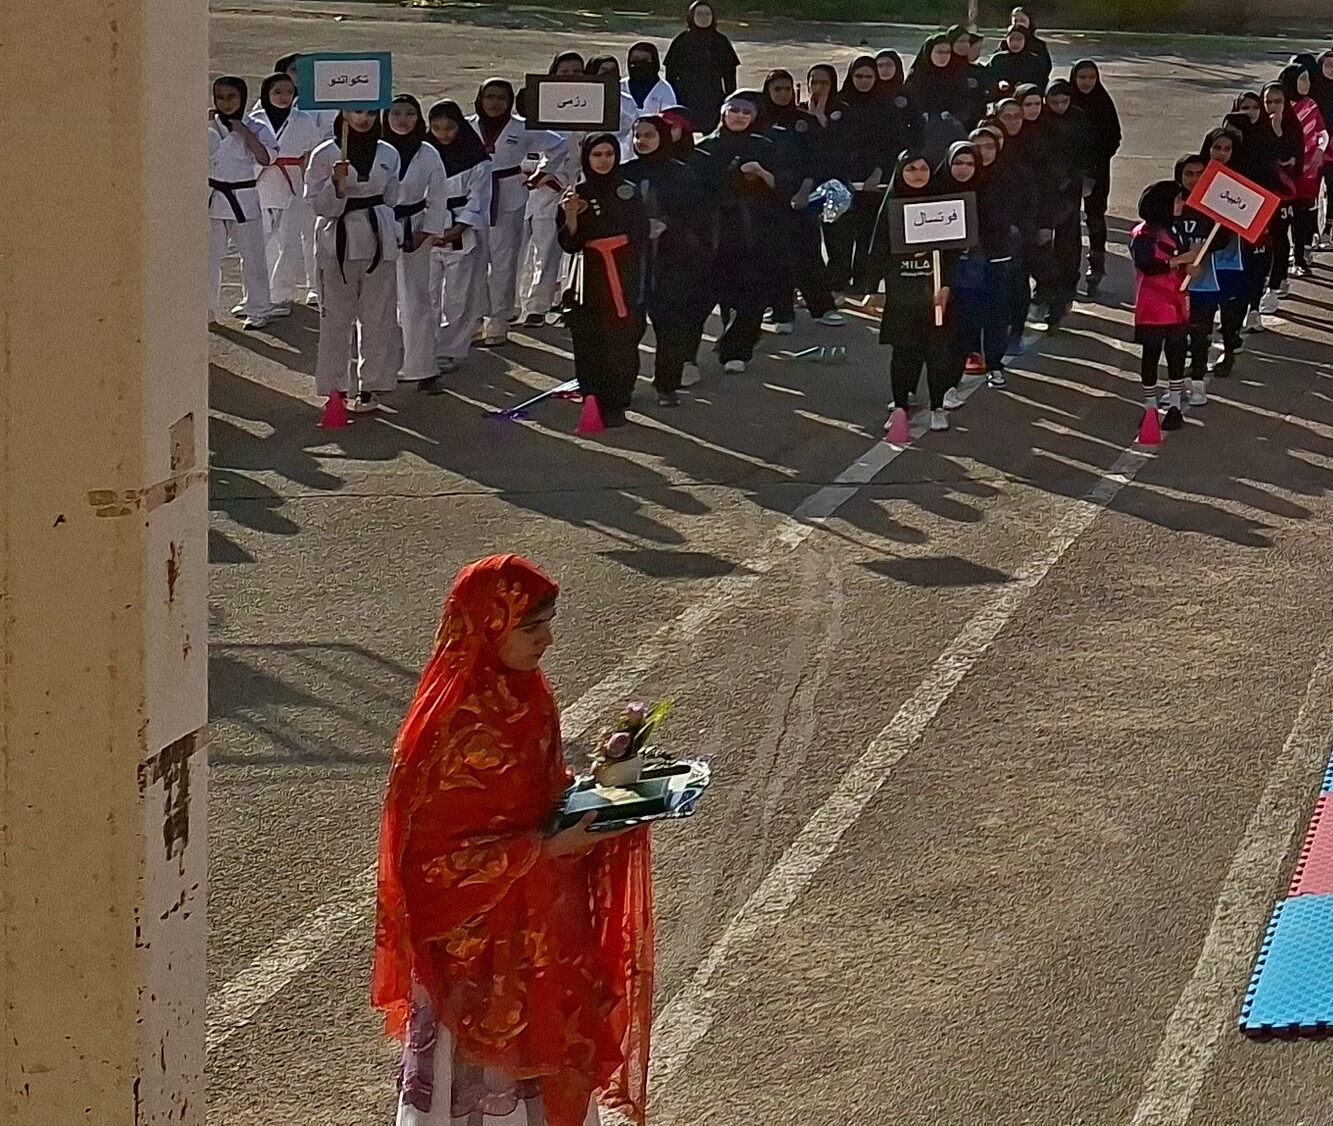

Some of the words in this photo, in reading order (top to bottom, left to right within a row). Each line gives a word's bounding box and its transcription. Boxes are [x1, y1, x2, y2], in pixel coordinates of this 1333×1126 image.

[328, 75, 369, 87] تکواندو
[557, 95, 587, 109] رزمی
[1219, 190, 1247, 210] والیبال
[913, 209, 958, 227] فوتسال
[1183, 220, 1197, 233] 17
